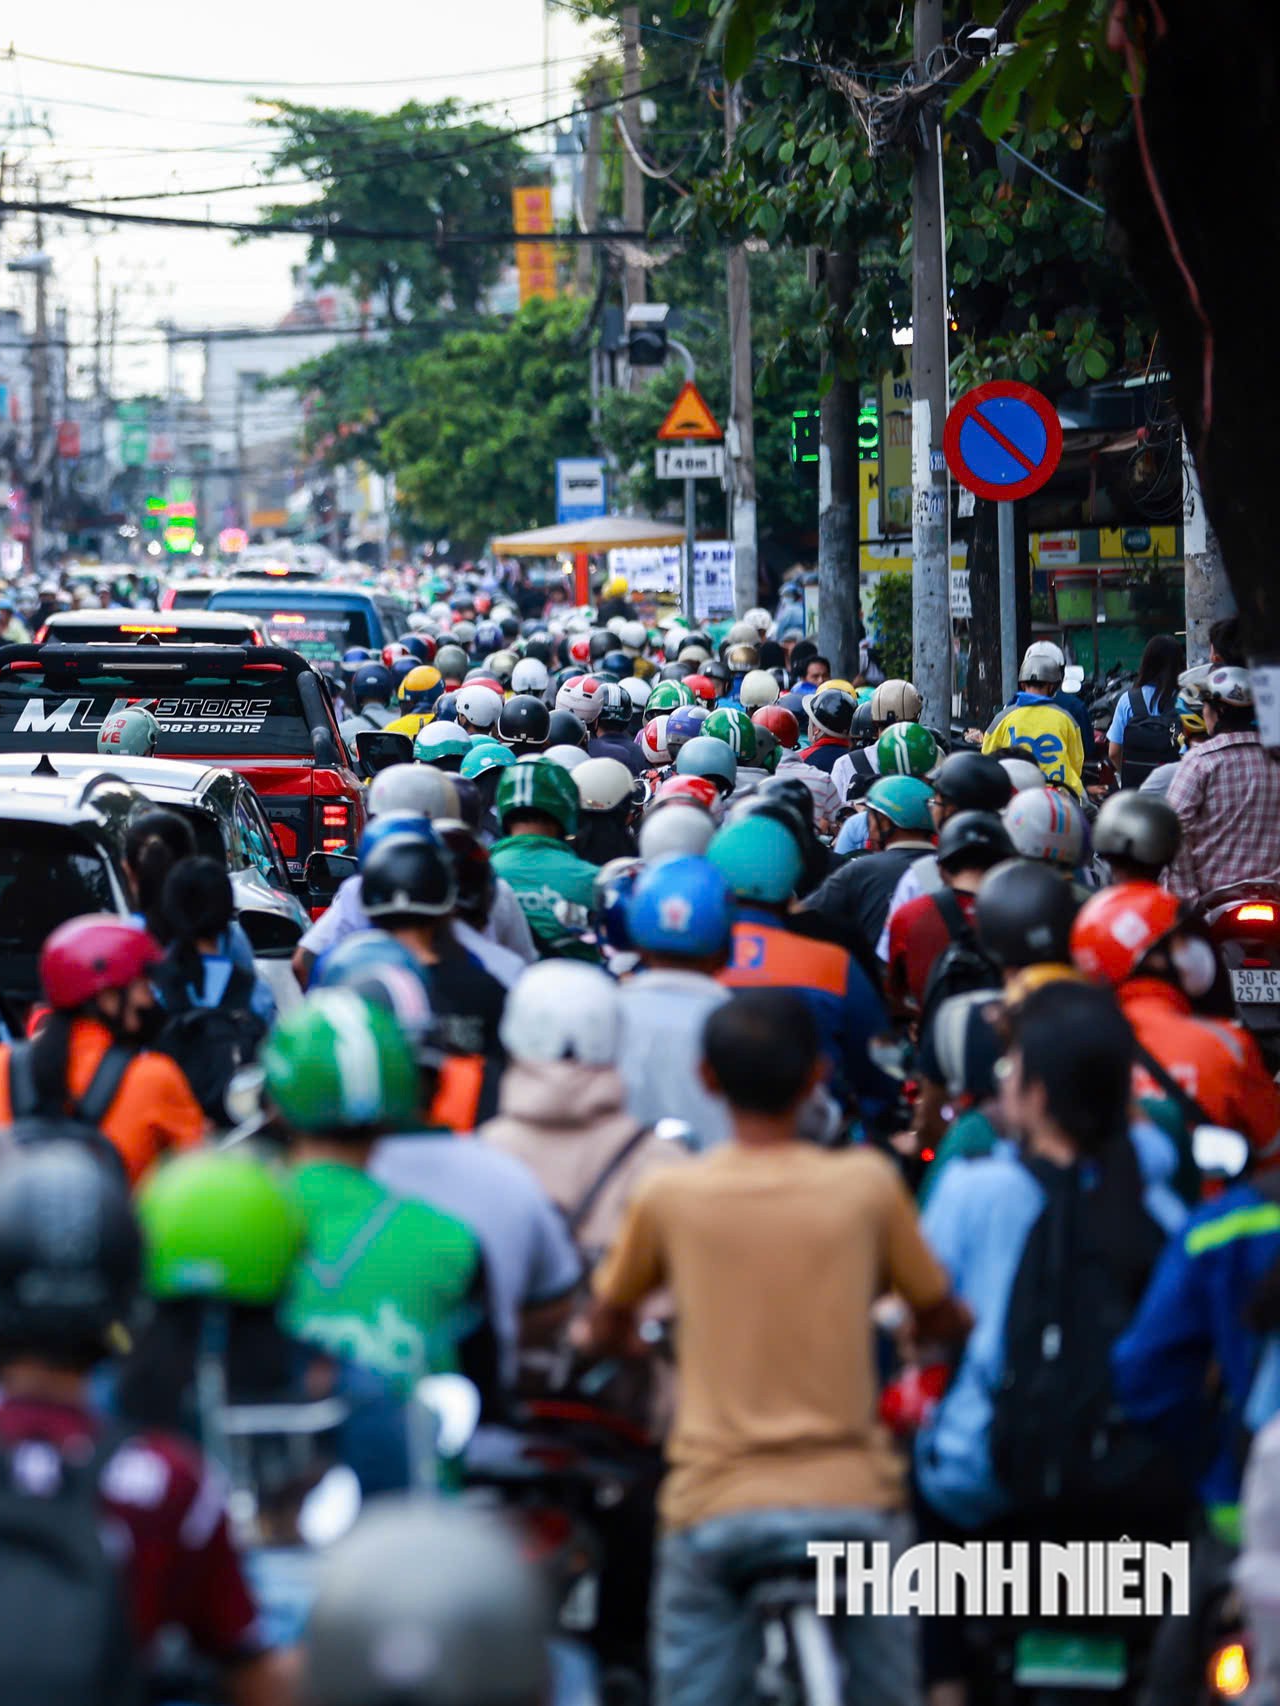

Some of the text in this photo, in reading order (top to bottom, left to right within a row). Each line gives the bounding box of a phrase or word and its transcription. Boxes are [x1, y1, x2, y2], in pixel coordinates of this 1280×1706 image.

[154, 698, 271, 717] STORE
[160, 723, 261, 733] 982.99.1212
[101, 731, 121, 743] VE
[1008, 725, 1063, 764] be
[515, 884, 562, 911] rab
[1238, 971, 1278, 985] 50-AC
